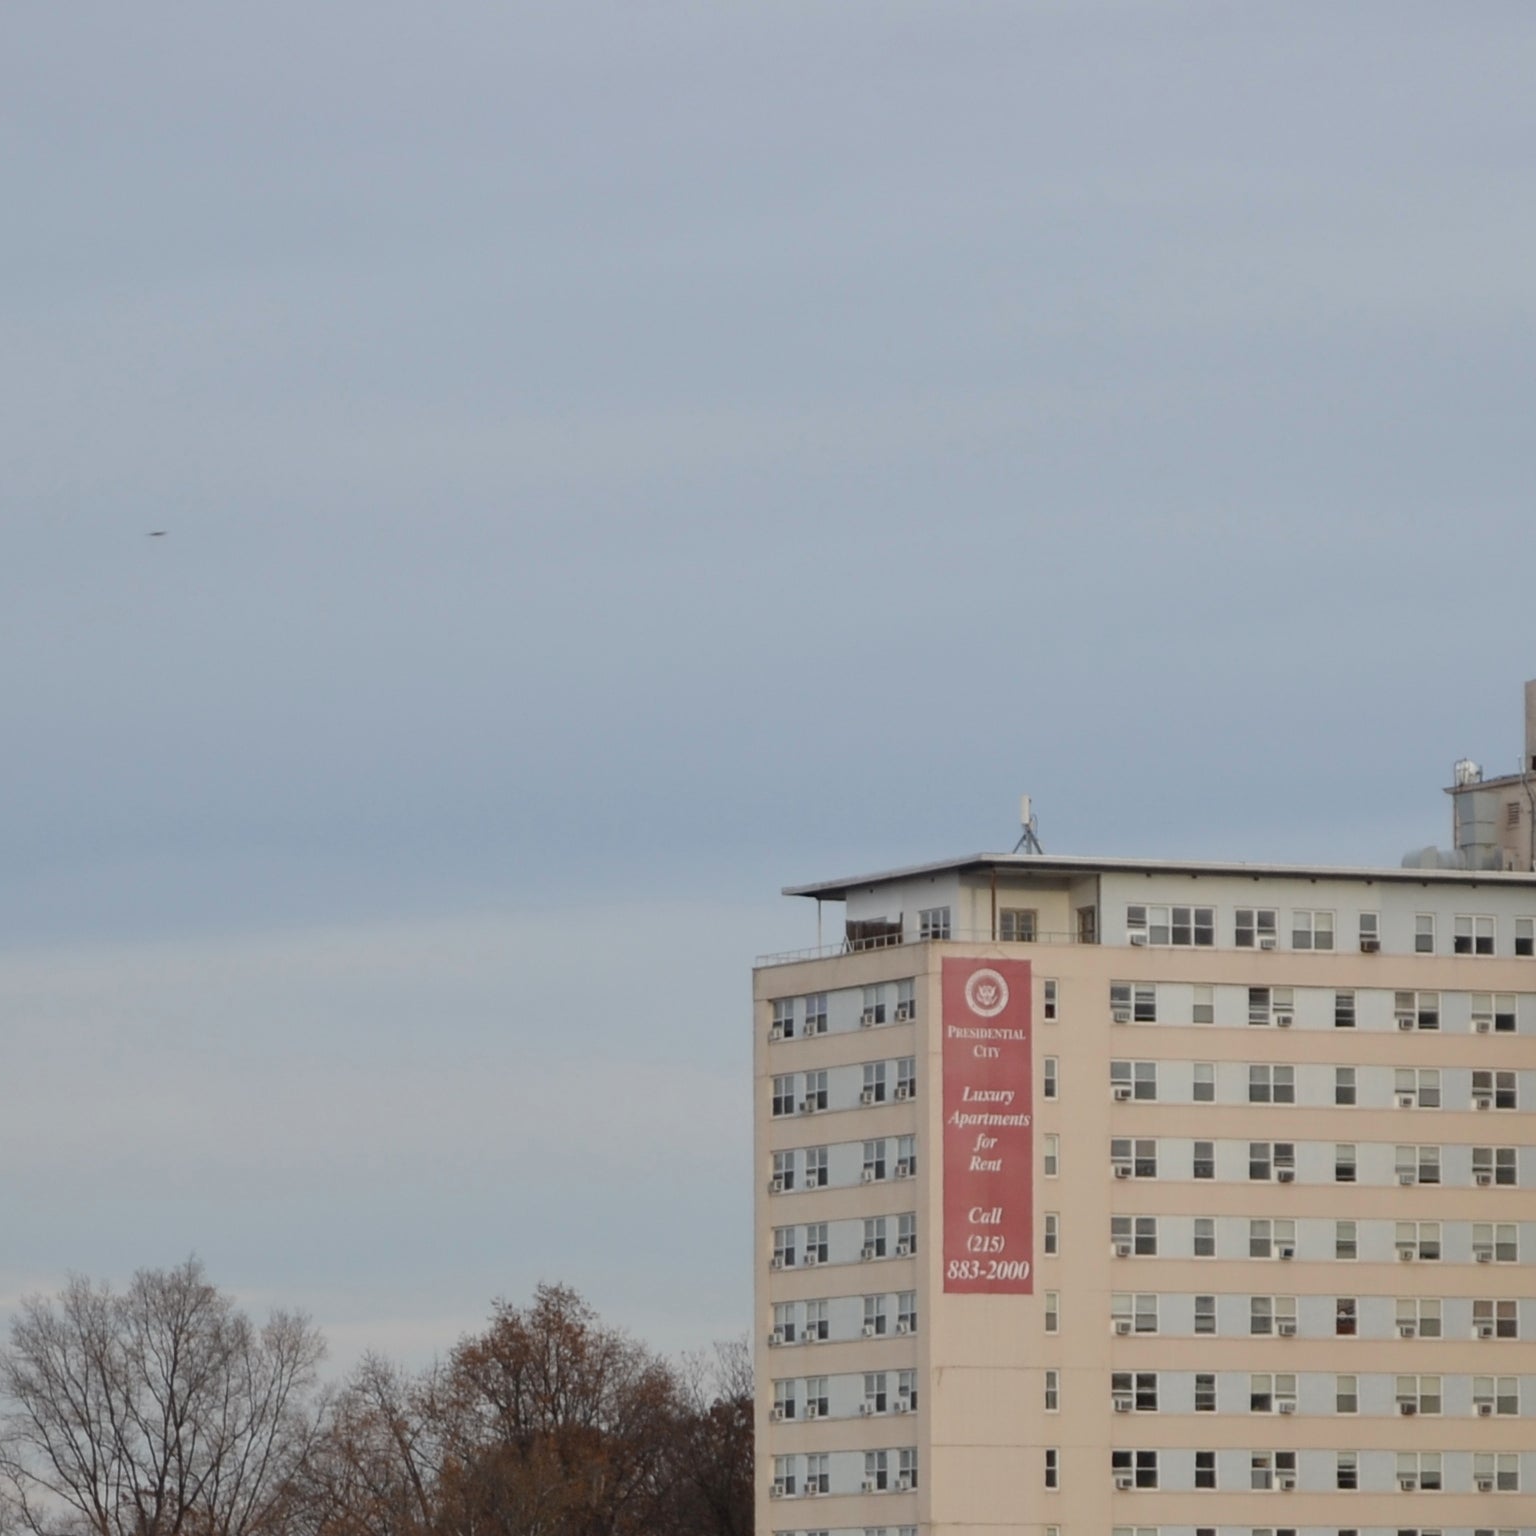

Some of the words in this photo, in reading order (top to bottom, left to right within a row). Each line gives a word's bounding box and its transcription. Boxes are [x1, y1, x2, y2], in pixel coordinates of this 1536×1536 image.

[948, 1025, 1026, 1041] PRESIDENTIAL
[973, 1045, 1001, 1058] CITY
[963, 1087, 1014, 1105] Luxury
[949, 1111, 1031, 1128] Apartments
[974, 1132, 997, 1152] for
[969, 1155, 1002, 1172] Rent
[968, 1206, 1001, 1224] Call
[967, 1235, 1005, 1253] (215)
[947, 1260, 1030, 1280] 883-2000
